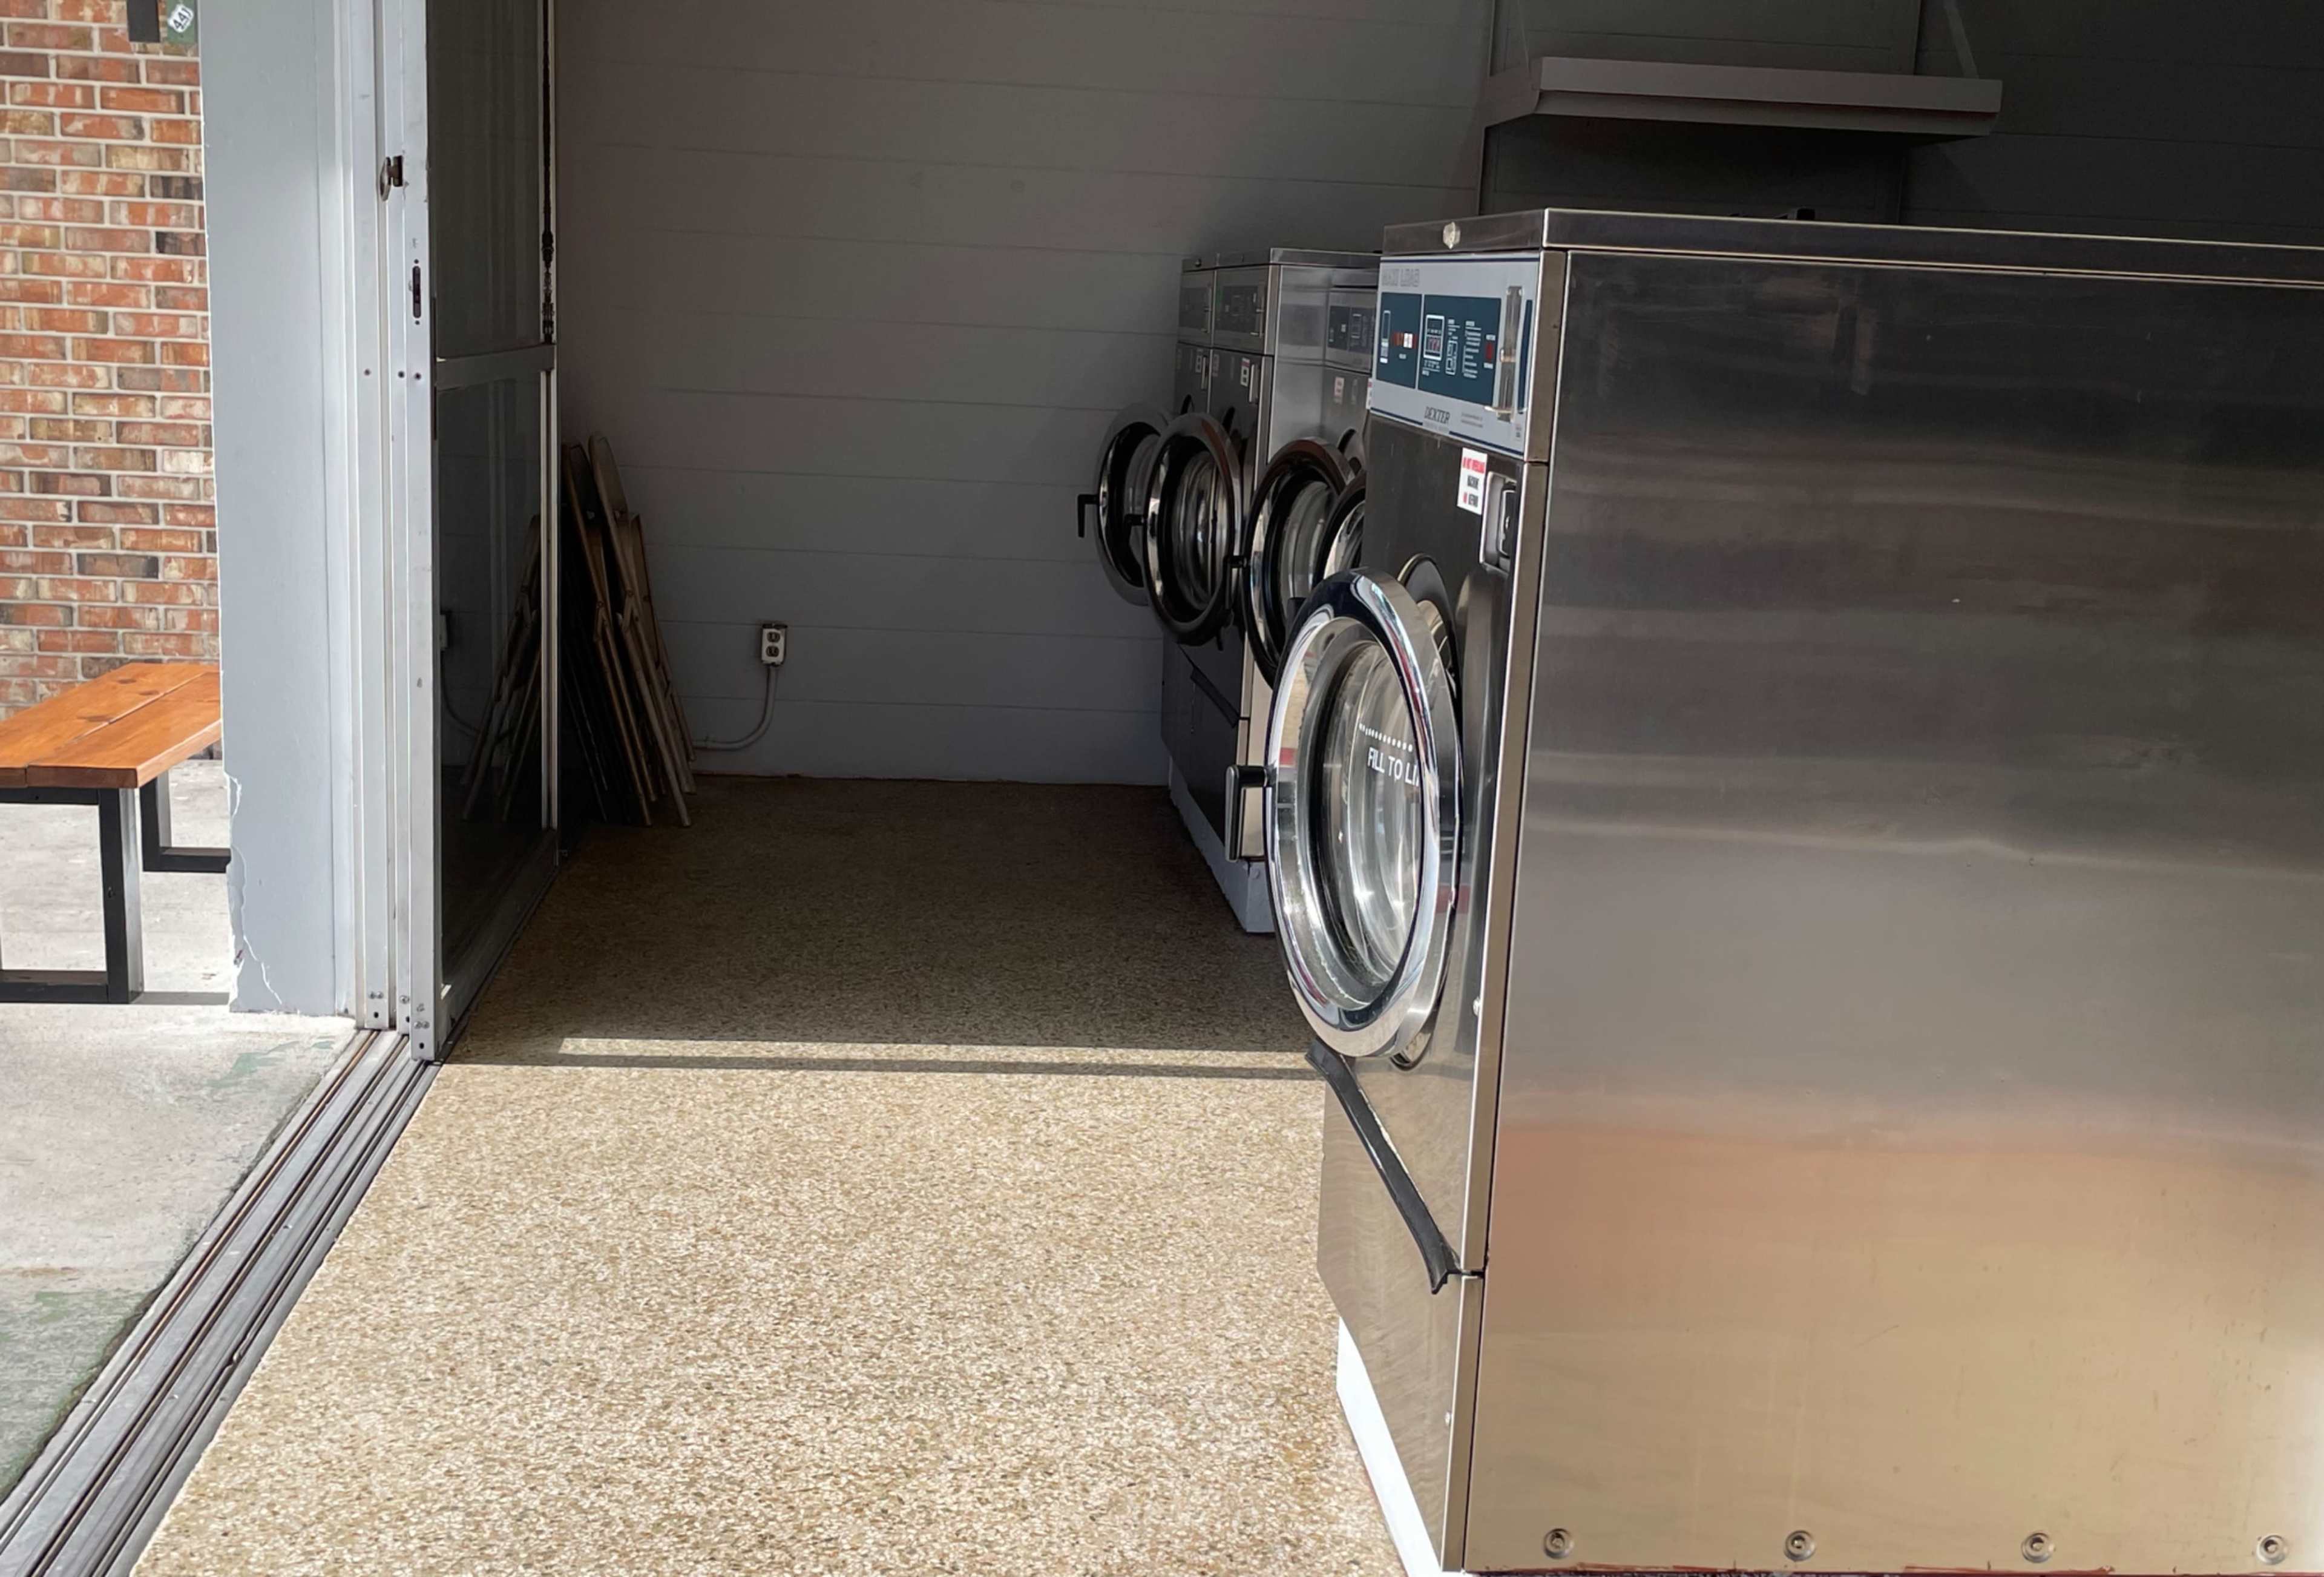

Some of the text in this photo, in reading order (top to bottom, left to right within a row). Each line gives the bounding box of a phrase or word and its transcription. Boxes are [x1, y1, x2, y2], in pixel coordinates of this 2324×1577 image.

[1424, 406, 1450, 424] DEXTER
[1368, 747, 1385, 774] FILL
[1388, 756, 1403, 780] TO
